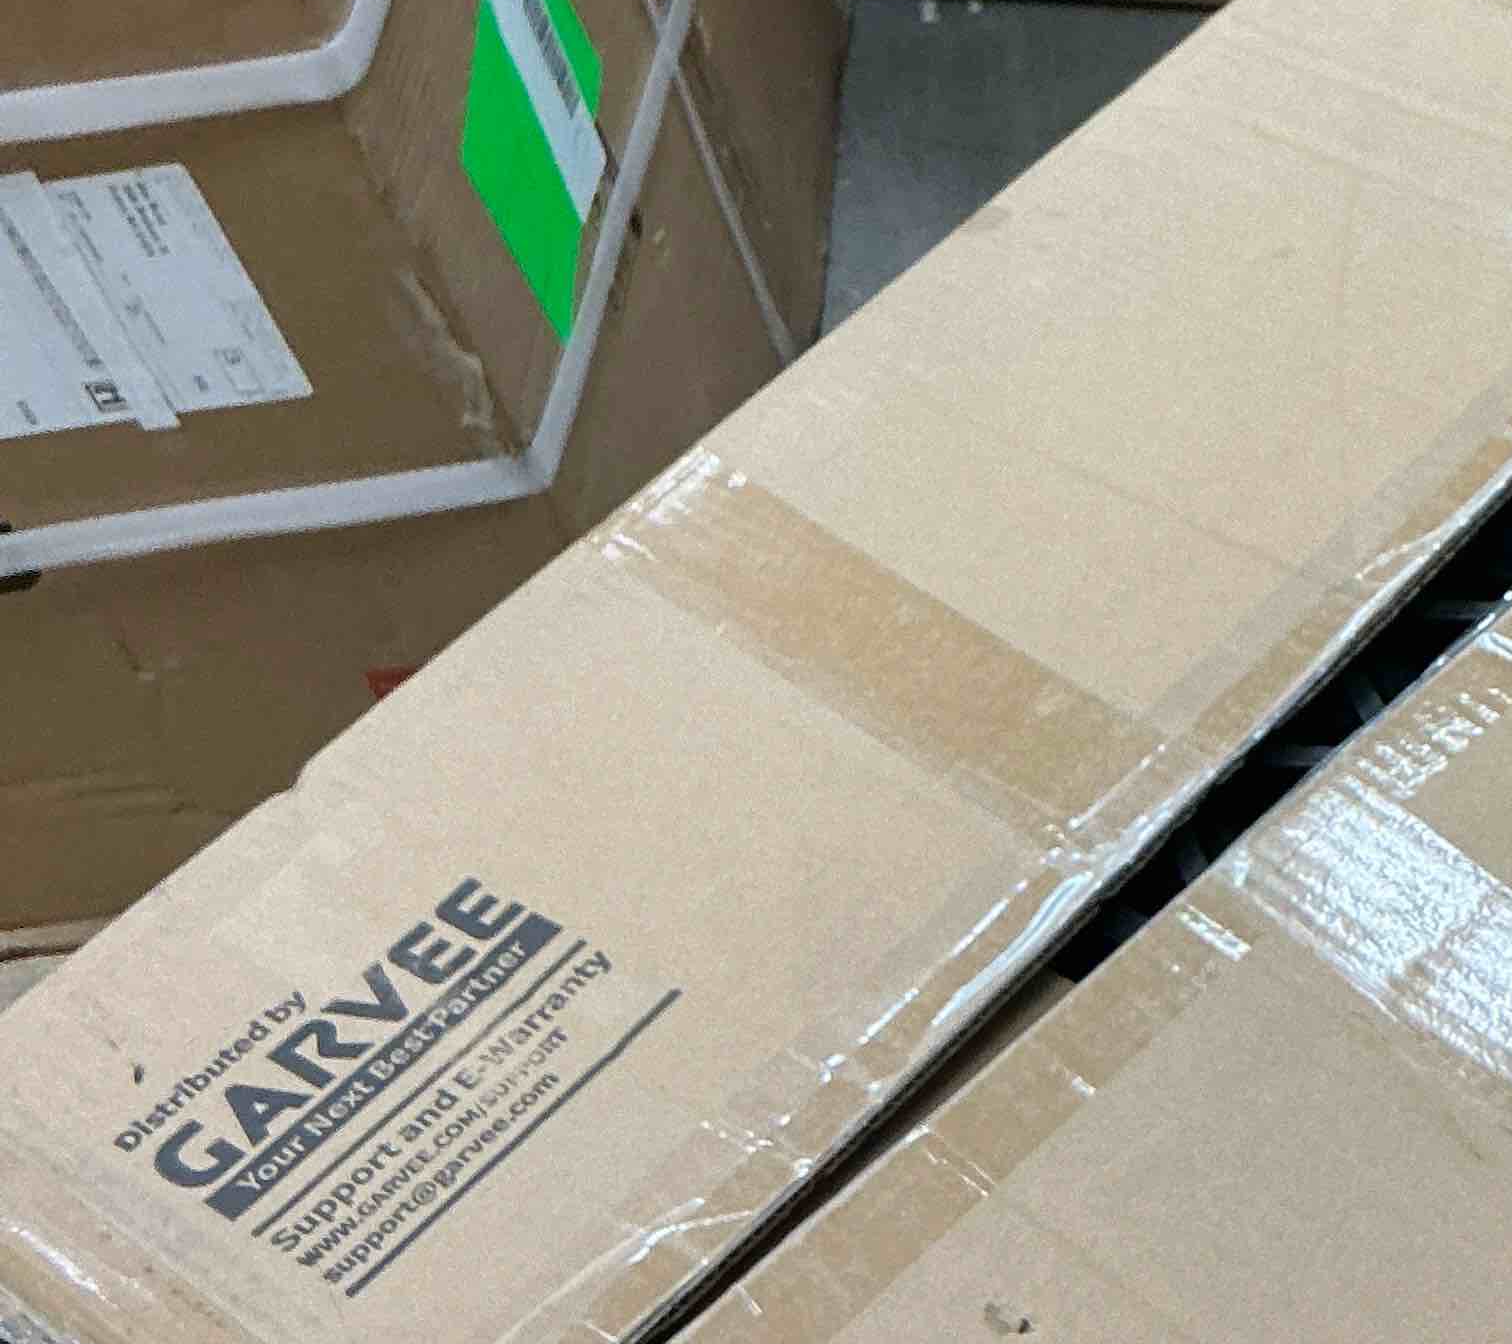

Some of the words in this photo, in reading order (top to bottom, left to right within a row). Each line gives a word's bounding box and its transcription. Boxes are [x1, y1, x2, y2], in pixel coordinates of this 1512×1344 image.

[114, 1020, 273, 1153] Distributed
[264, 991, 307, 1024] by
[154, 877, 526, 1188] GARVEE
[235, 1134, 305, 1190] Your
[304, 1080, 376, 1136] Next
[368, 1025, 435, 1081] Best
[429, 939, 526, 1028] Partner
[271, 1141, 402, 1253] Support
[399, 1088, 459, 1143] and
[453, 951, 612, 1090] E-Warranty
[323, 1072, 560, 1283] support@garvee.com
